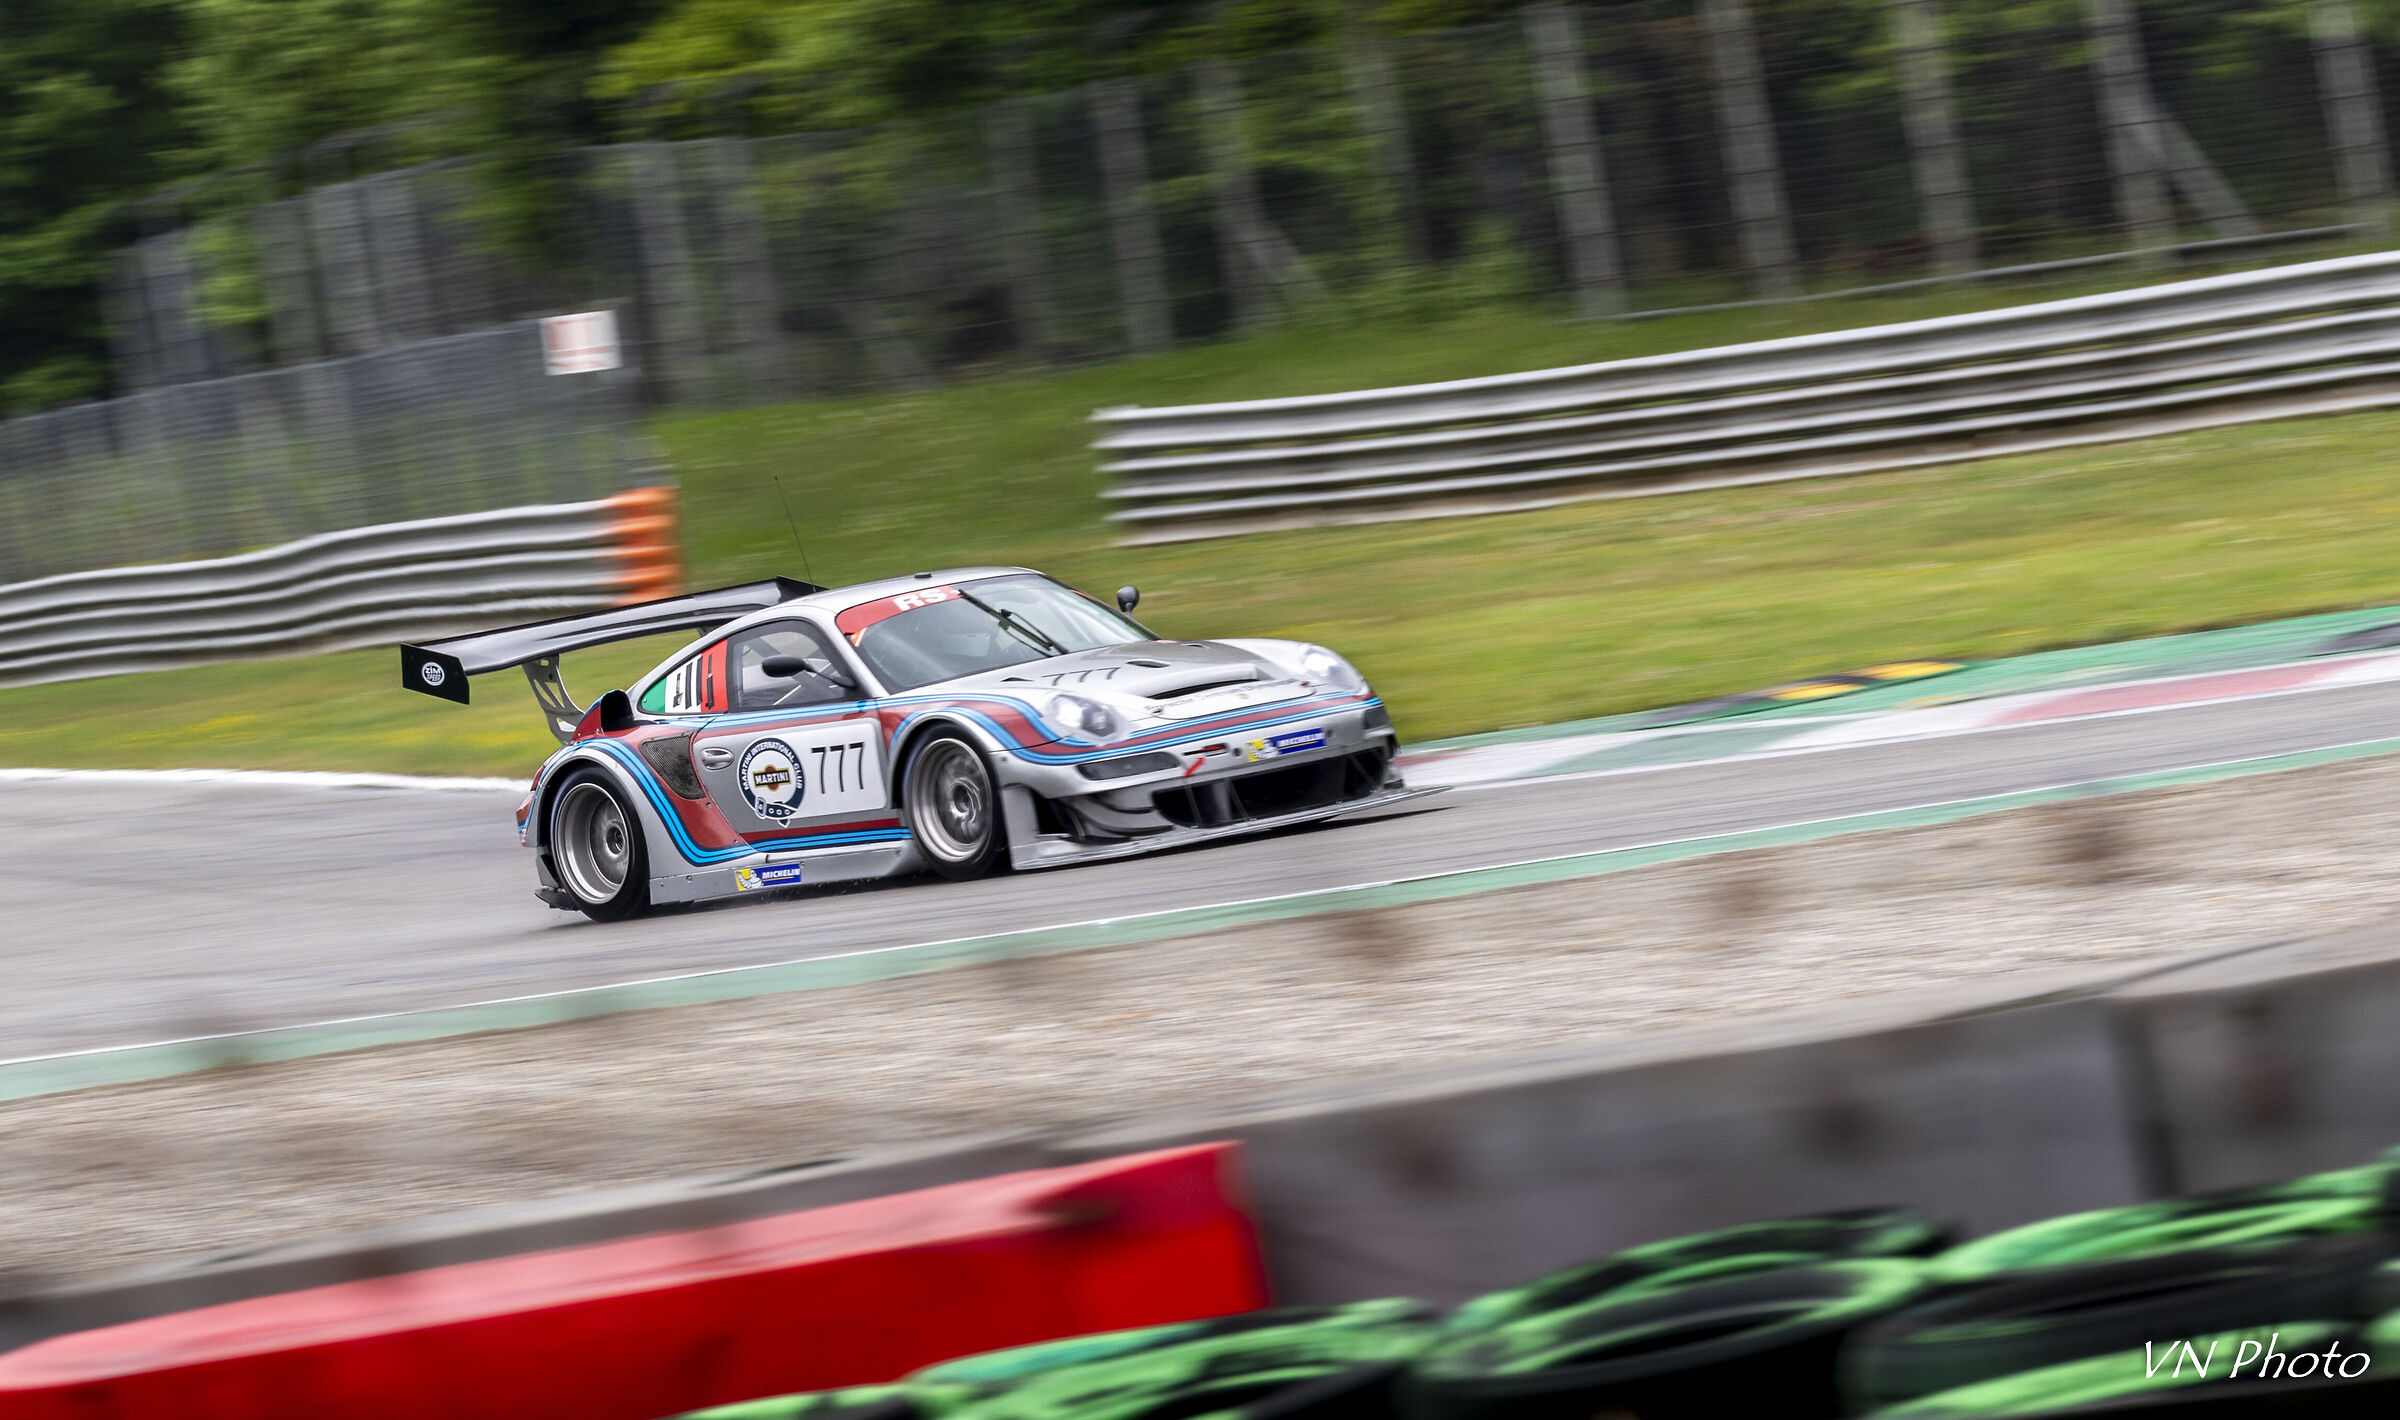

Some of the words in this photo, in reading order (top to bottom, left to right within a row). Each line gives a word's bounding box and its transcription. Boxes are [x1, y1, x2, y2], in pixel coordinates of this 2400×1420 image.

[1041, 666, 1121, 686] 777
[1276, 732, 1325, 747] MICHELIN
[741, 752, 753, 790] MARTINI
[750, 741, 795, 763] INTERNATIONAL
[811, 742, 864, 794] 777
[755, 772, 789, 785] MARTINI
[762, 868, 801, 879] MICHELIN
